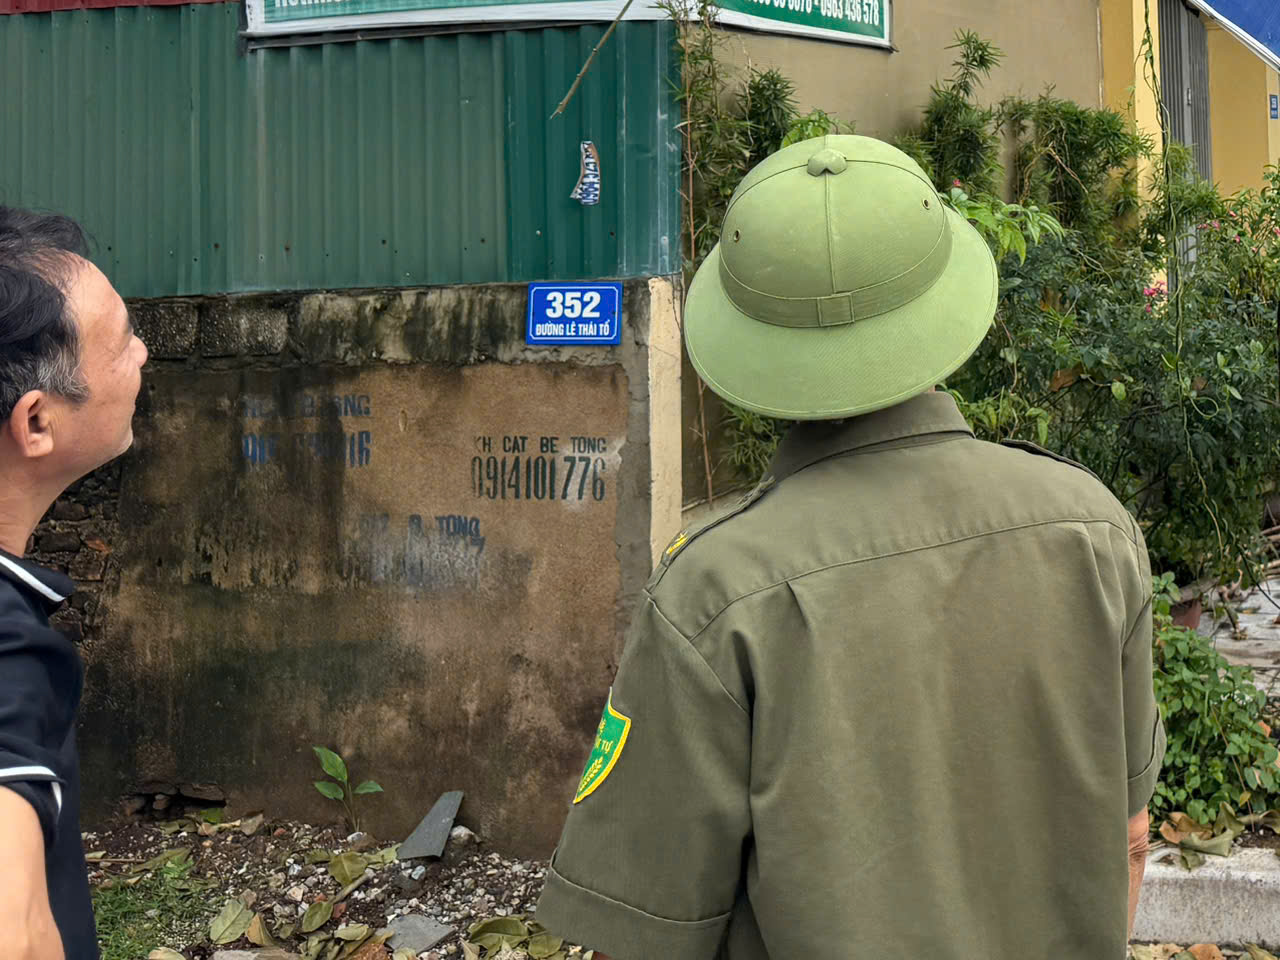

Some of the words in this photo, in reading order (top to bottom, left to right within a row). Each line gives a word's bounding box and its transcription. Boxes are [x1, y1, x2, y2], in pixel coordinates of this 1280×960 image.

[545, 291, 601, 318] 352
[535, 320, 564, 336] ĐƯỜNG
[566, 321, 577, 336] LÊ
[578, 321, 597, 336] THÁI
[503, 436, 528, 453] CAT
[540, 436, 559, 453] BE
[570, 436, 607, 453] TONG
[471, 456, 606, 501] 0914101776
